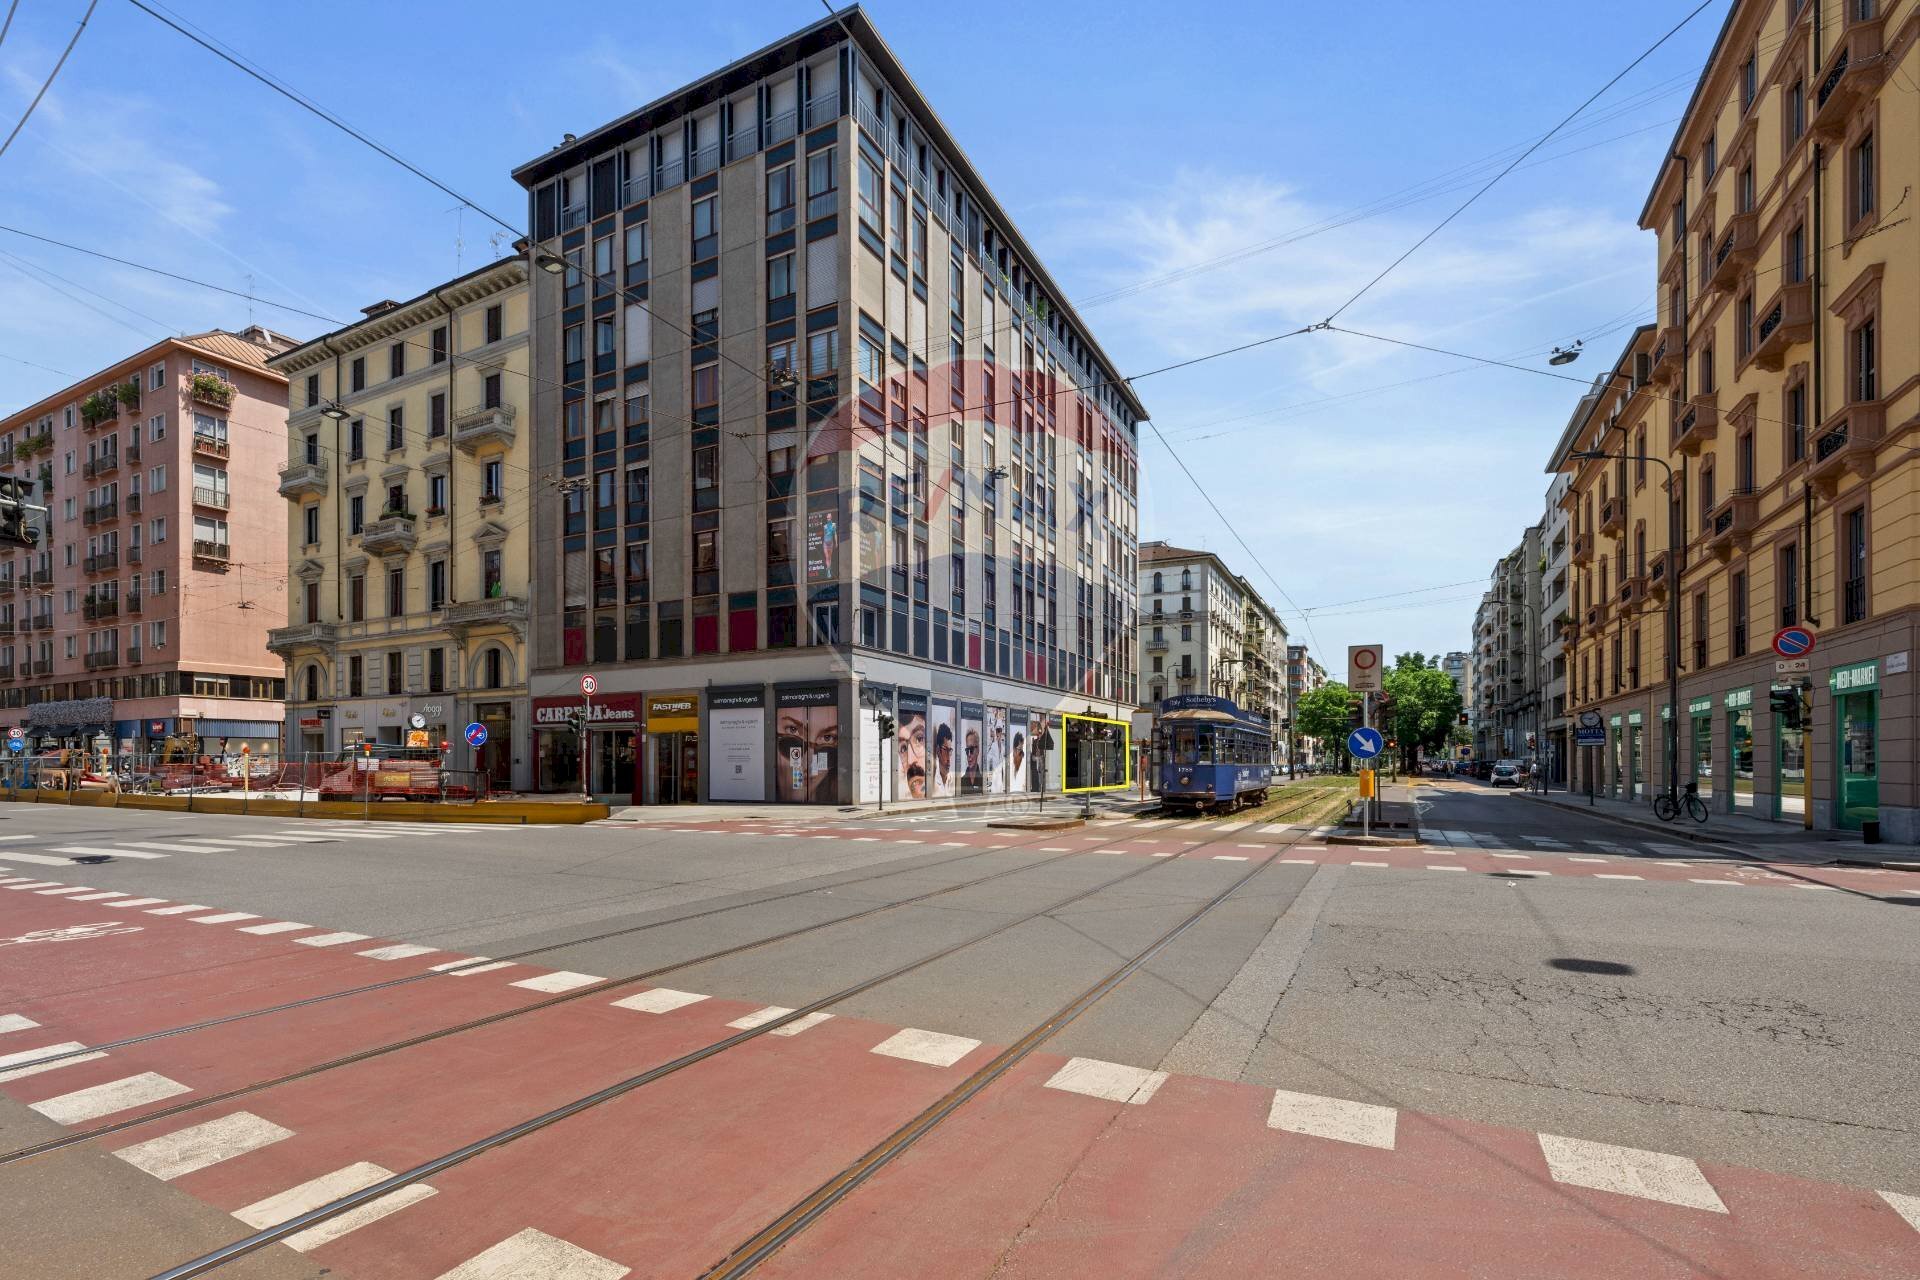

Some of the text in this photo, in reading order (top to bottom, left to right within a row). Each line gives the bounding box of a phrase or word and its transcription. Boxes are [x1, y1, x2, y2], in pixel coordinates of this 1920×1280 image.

[584, 680, 594, 690] 30
[652, 702, 692, 712] FASTWEB
[603, 708, 635, 720] Jeans
